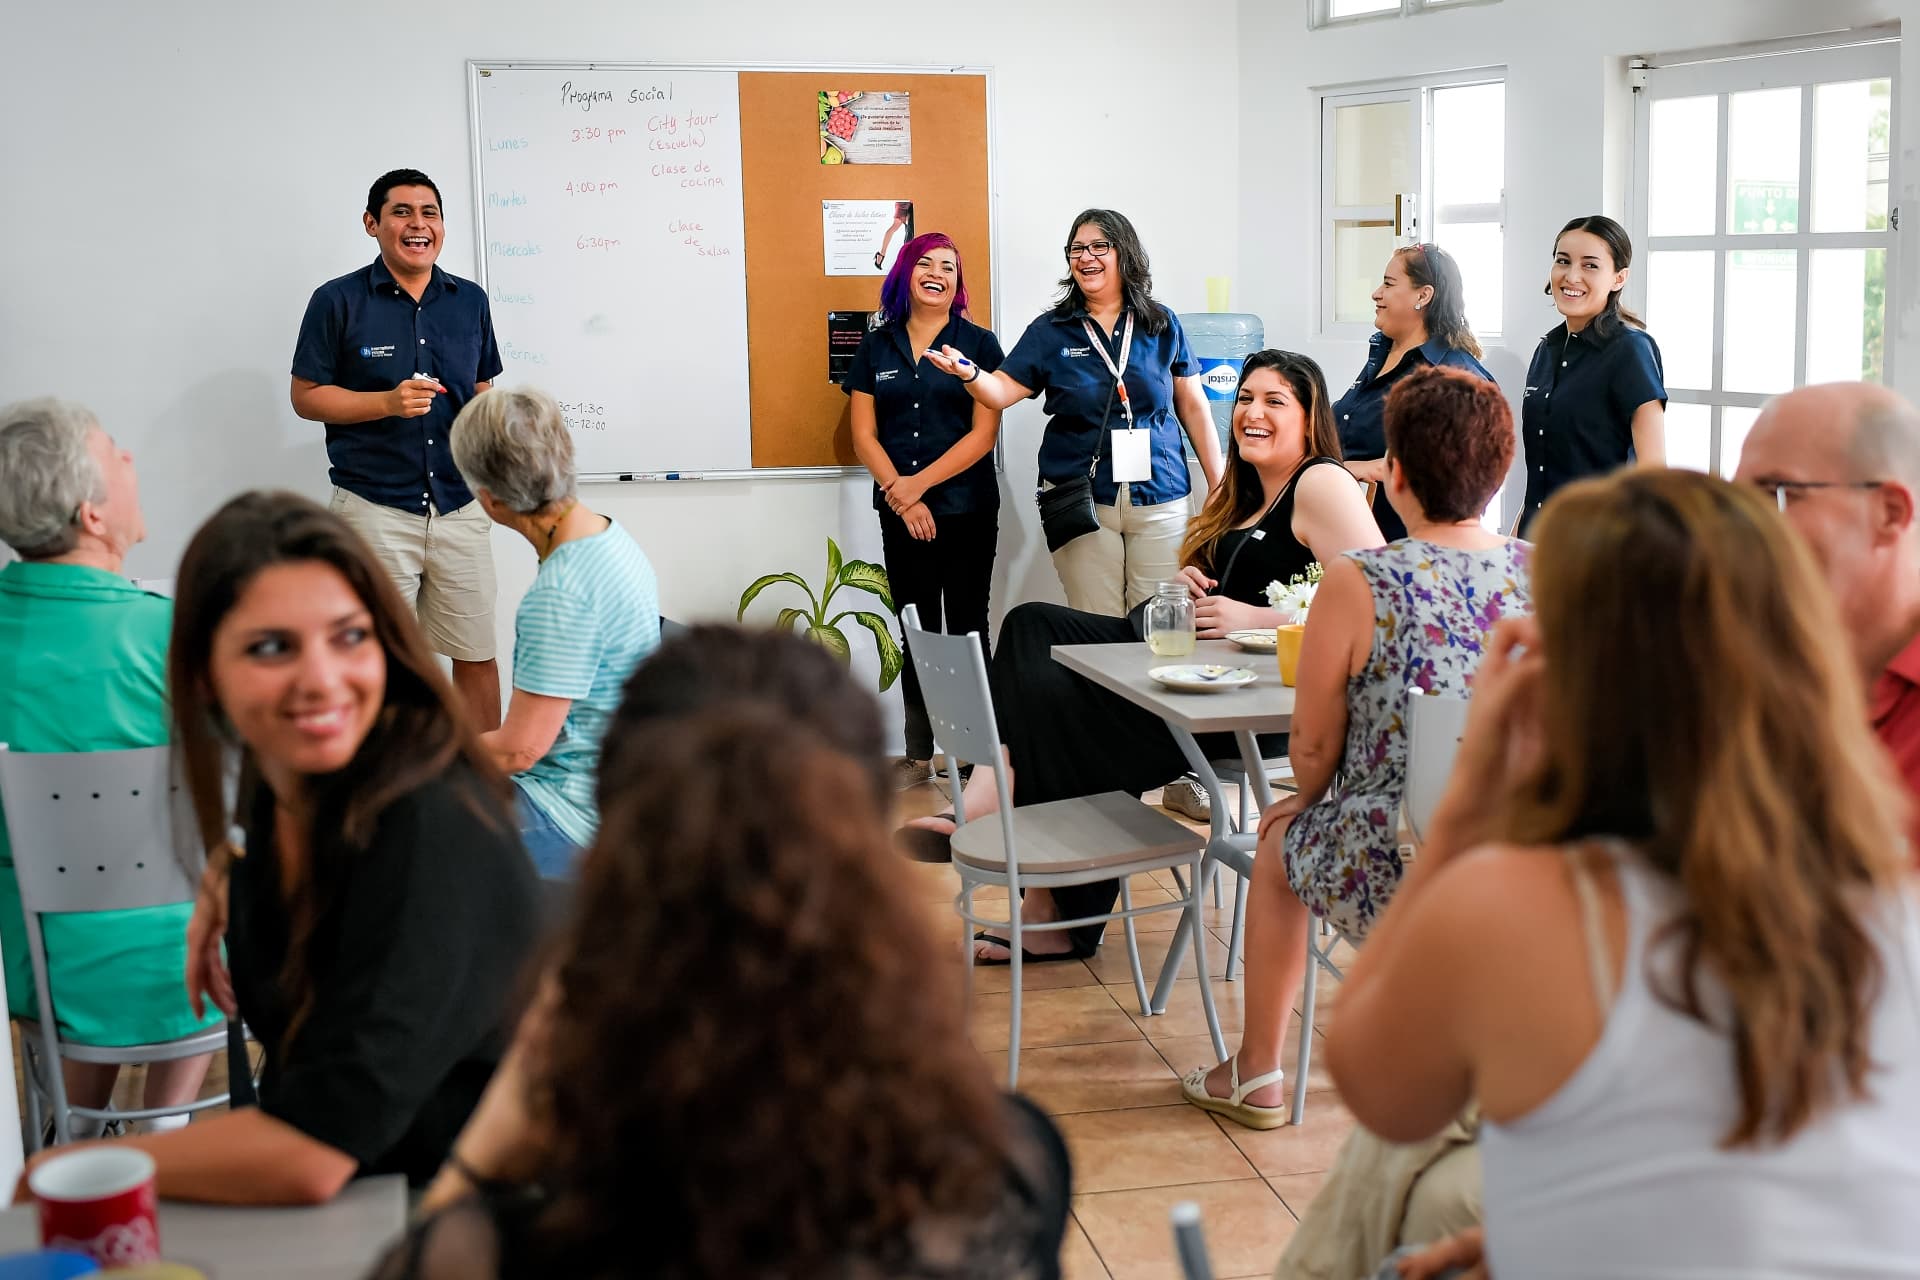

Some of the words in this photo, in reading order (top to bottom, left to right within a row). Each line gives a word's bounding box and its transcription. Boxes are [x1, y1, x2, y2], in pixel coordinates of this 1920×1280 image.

[561, 81, 613, 112] Programa
[648, 113, 677, 135] City
[685, 108, 719, 128] tour
[572, 127, 601, 143] 3:30
[608, 129, 626, 144] pm
[488, 136, 529, 152] Lunes
[694, 160, 711, 173] de
[565, 181, 596, 197] 4:00
[600, 182, 618, 197] pm
[680, 177, 725, 188] cocina
[488, 189, 528, 209] Martes
[684, 235, 701, 247] de
[493, 286, 535, 304] Jueves
[1208, 375, 1237, 385] cristal
[559, 400, 604, 416] 30-1:30
